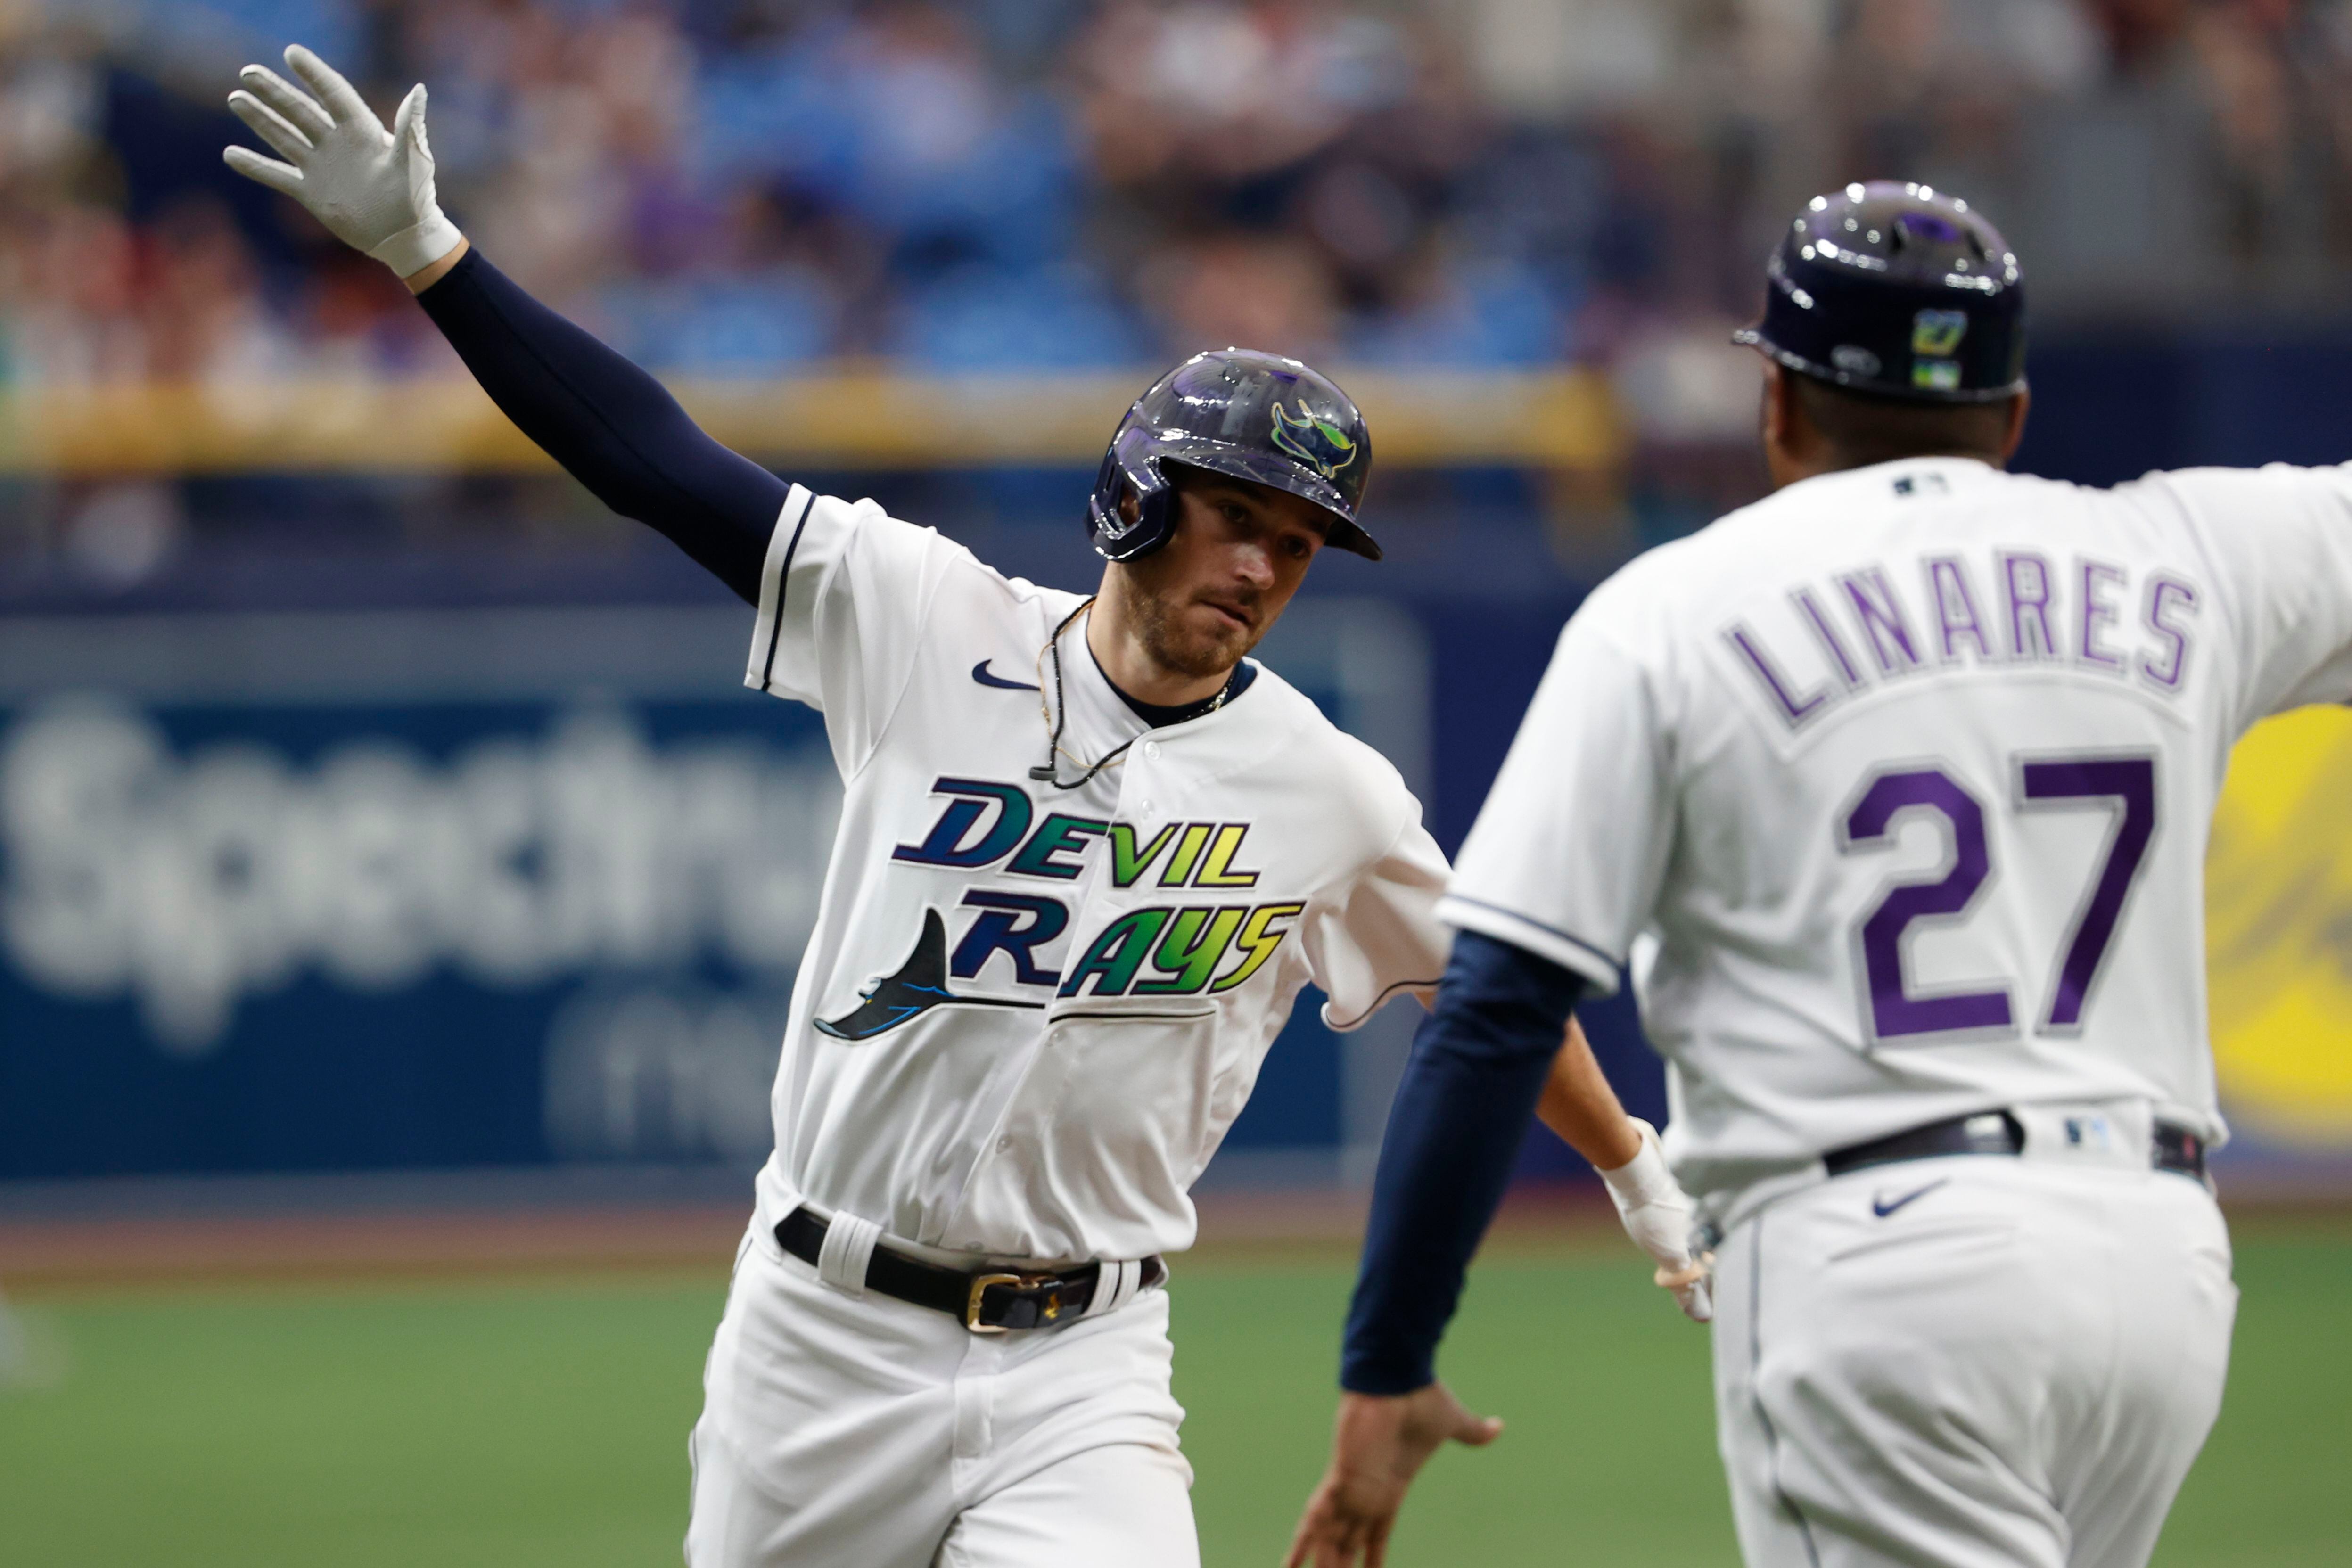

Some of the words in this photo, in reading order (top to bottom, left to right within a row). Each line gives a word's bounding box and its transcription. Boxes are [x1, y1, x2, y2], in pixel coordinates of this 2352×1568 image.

[1722, 550, 2200, 729] LINARES
[892, 775, 1259, 888] DEVIL
[1834, 746, 2160, 1050] 27
[950, 889, 1307, 998] RAYS
